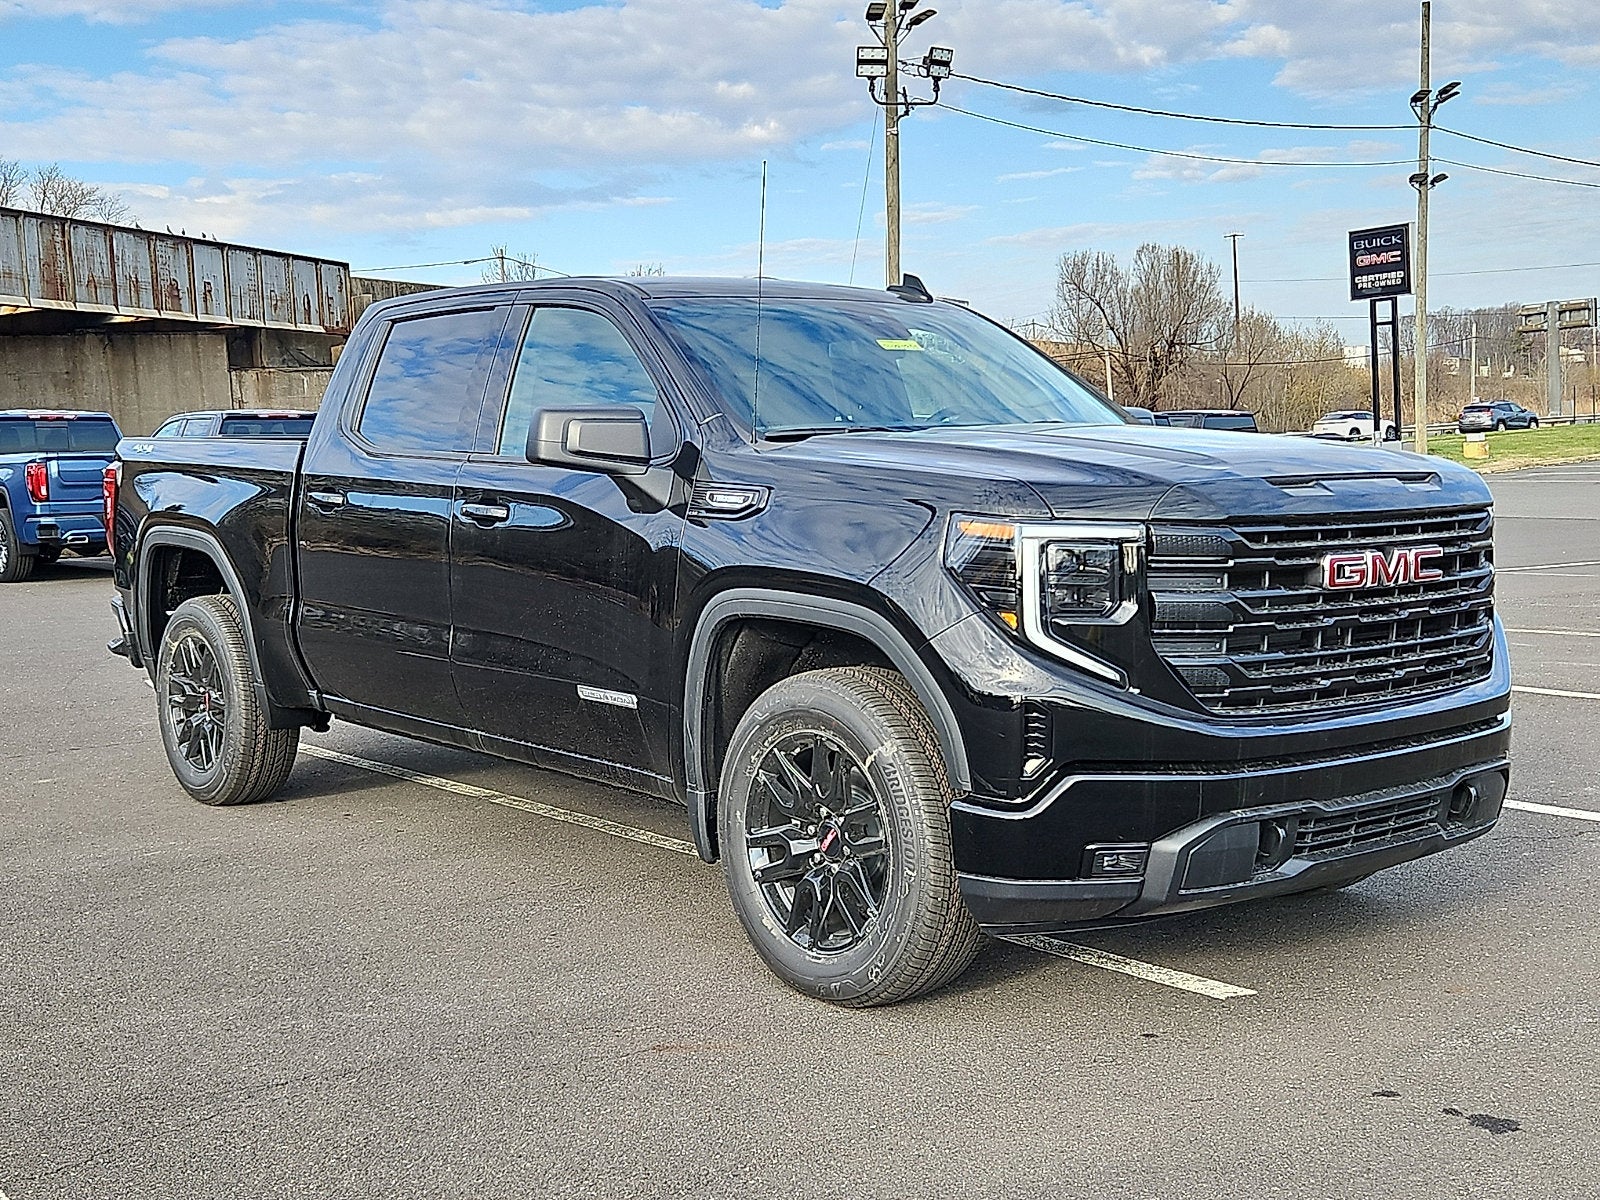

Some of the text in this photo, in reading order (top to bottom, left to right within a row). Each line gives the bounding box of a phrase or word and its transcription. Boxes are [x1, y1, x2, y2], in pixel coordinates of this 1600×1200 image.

[1353, 234, 1403, 250] BUICK
[1356, 250, 1401, 267] GMC
[1354, 270, 1404, 284] CERTIFIED
[1357, 278, 1402, 290] PRE-OWNED
[1322, 546, 1443, 590] GMC
